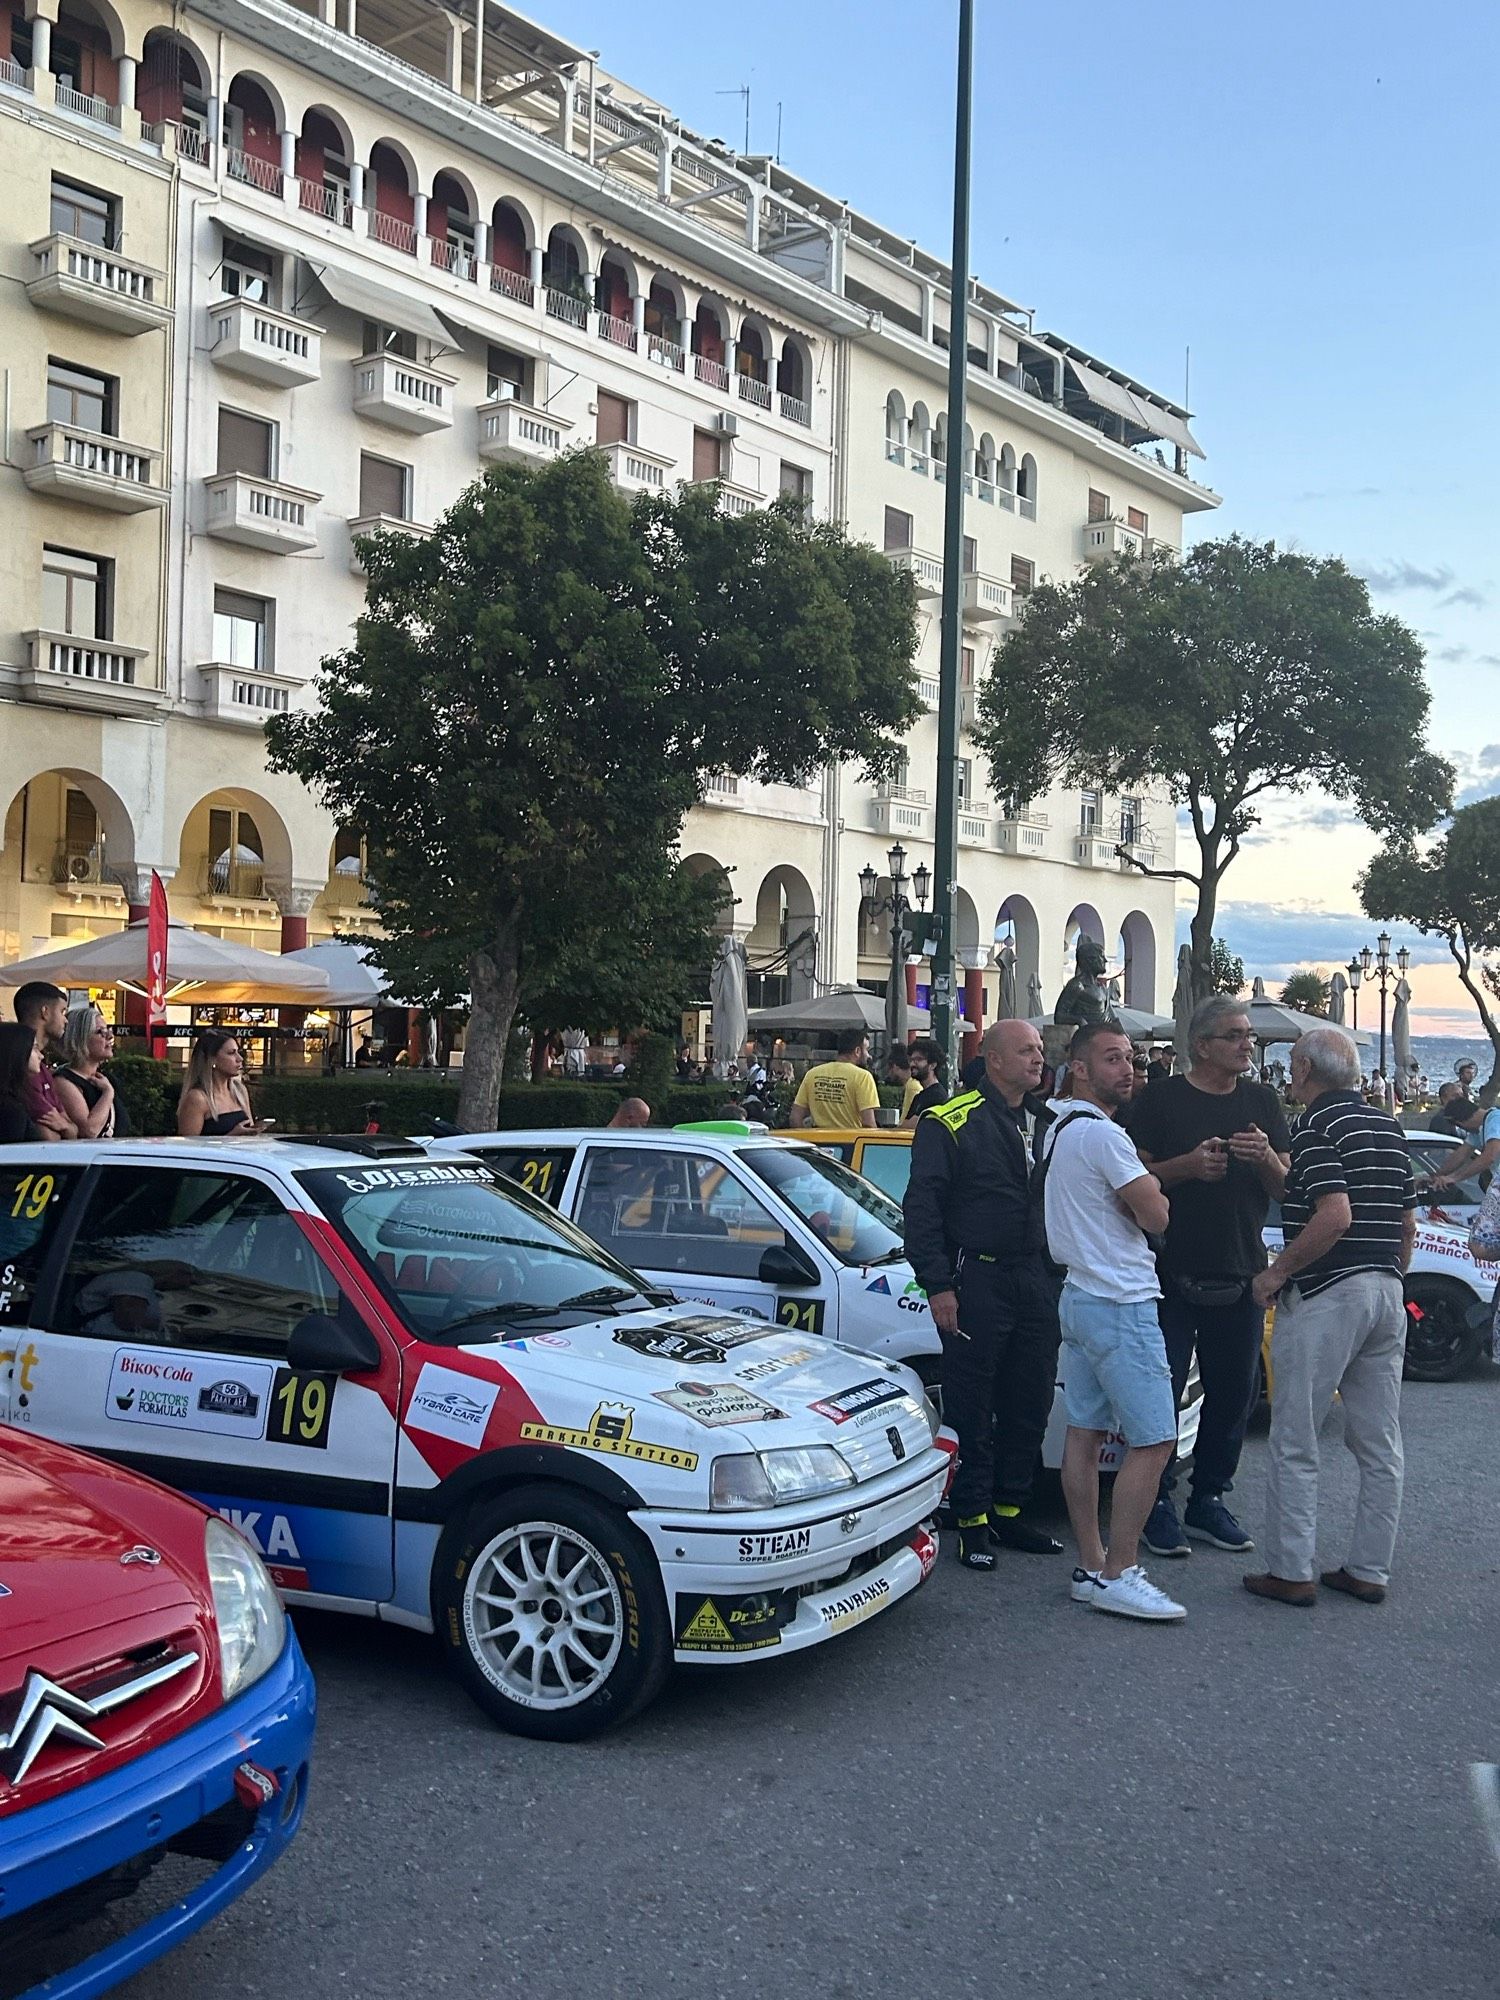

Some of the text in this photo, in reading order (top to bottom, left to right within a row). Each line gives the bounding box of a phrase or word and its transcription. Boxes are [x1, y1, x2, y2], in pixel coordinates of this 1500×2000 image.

[116, 1027, 130, 1036] KFC
[174, 1028, 194, 1036] KFC
[236, 1029, 254, 1037] KFC
[294, 1030, 311, 1038] KFC
[361, 1166, 496, 1186] Disabled
[521, 1161, 553, 1193] 21
[10, 1174, 55, 1218] 19
[897, 1296, 928, 1313] Car
[782, 1302, 816, 1334] 21
[120, 1357, 193, 1382] Βίκος Cola
[140, 1389, 189, 1406] DOCTOR'S
[225, 1384, 237, 1395] 56
[138, 1401, 188, 1418] FORMULAS
[278, 1376, 327, 1439] 19
[414, 1395, 452, 1413] HYBRID
[453, 1408, 483, 1424] CARE
[595, 1416, 625, 1440] S
[524, 1428, 692, 1468] PARKING STATION
[738, 1529, 811, 1556] STEAM
[821, 1578, 890, 1622] MAVRAKIS
